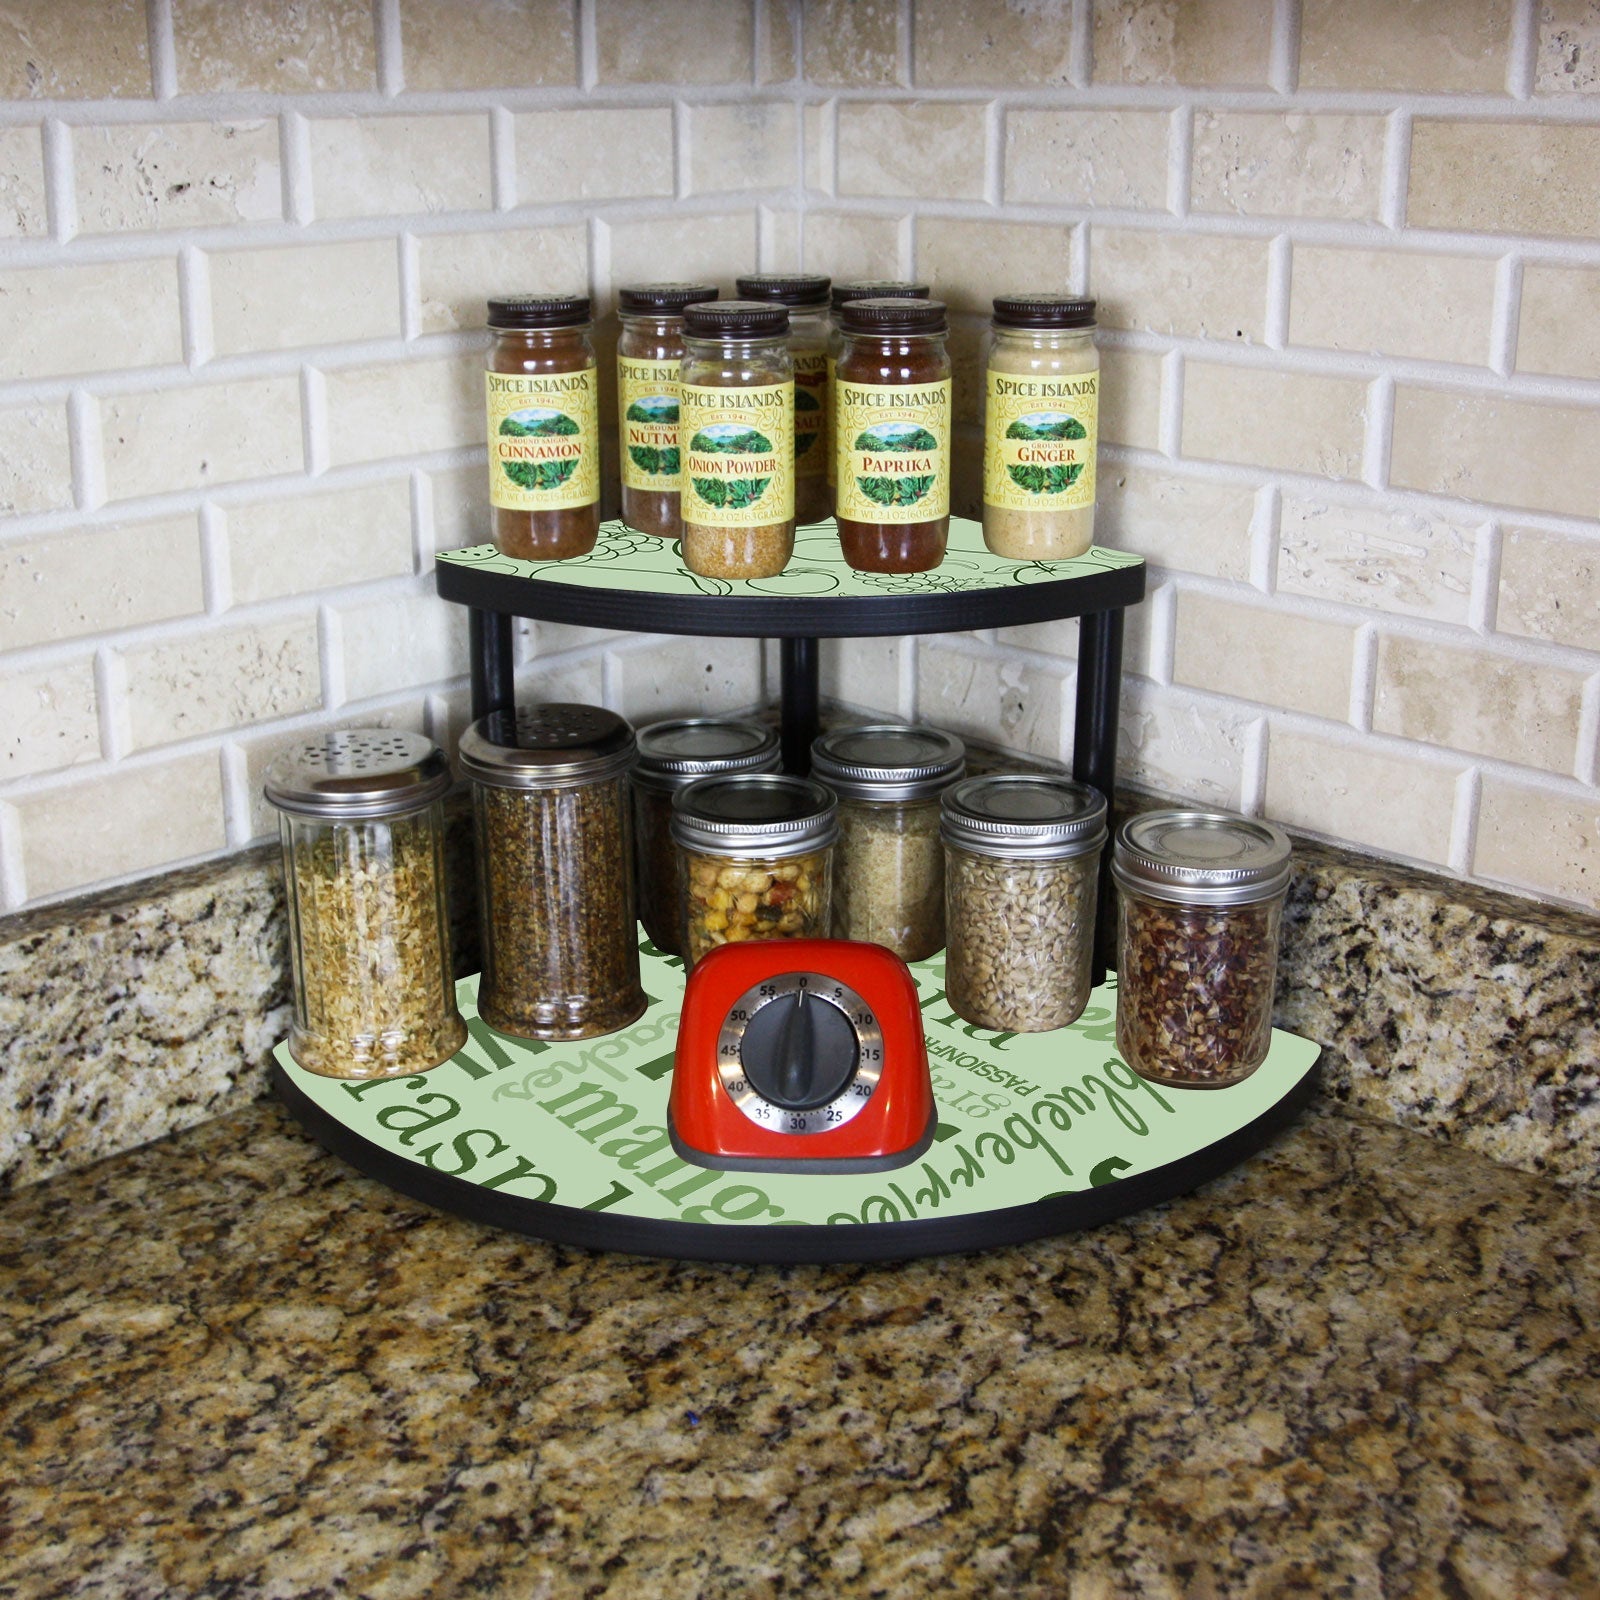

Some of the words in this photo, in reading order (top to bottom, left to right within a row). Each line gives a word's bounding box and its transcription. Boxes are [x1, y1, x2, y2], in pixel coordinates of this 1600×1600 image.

[620, 362, 649, 380] SPICE
[489, 376, 524, 392] SPICE
[529, 374, 588, 392] ISLANDS
[996, 378, 1038, 396] SPICE
[1041, 378, 1096, 397] ISLANDS
[682, 389, 716, 408] SPICE
[720, 389, 784, 408] ISLANDS
[844, 388, 885, 407] SPICE
[890, 387, 946, 407] ISLANDS
[542, 436, 569, 444] SAIGON
[629, 429, 680, 445] NUTM
[498, 443, 582, 458] CINNAMON
[1018, 447, 1076, 462] GINGER
[688, 456, 722, 474] ONION
[726, 458, 776, 474] POWDER
[862, 457, 932, 473] PAPRIKA
[800, 977, 808, 988] 0
[760, 986, 776, 996] 55
[834, 988, 842, 998] 5
[730, 1010, 747, 1022] 50
[857, 1013, 873, 1025] 10
[720, 1045, 737, 1056] 45
[865, 1049, 880, 1061] 15
[492, 1012, 682, 1102] eaches
[728, 1081, 744, 1092] 40
[856, 1085, 872, 1096] 20
[754, 1108, 770, 1119] 35
[826, 1110, 842, 1122] 25
[790, 1118, 806, 1130] 30
[827, 1057, 1176, 1226] blueberrie
